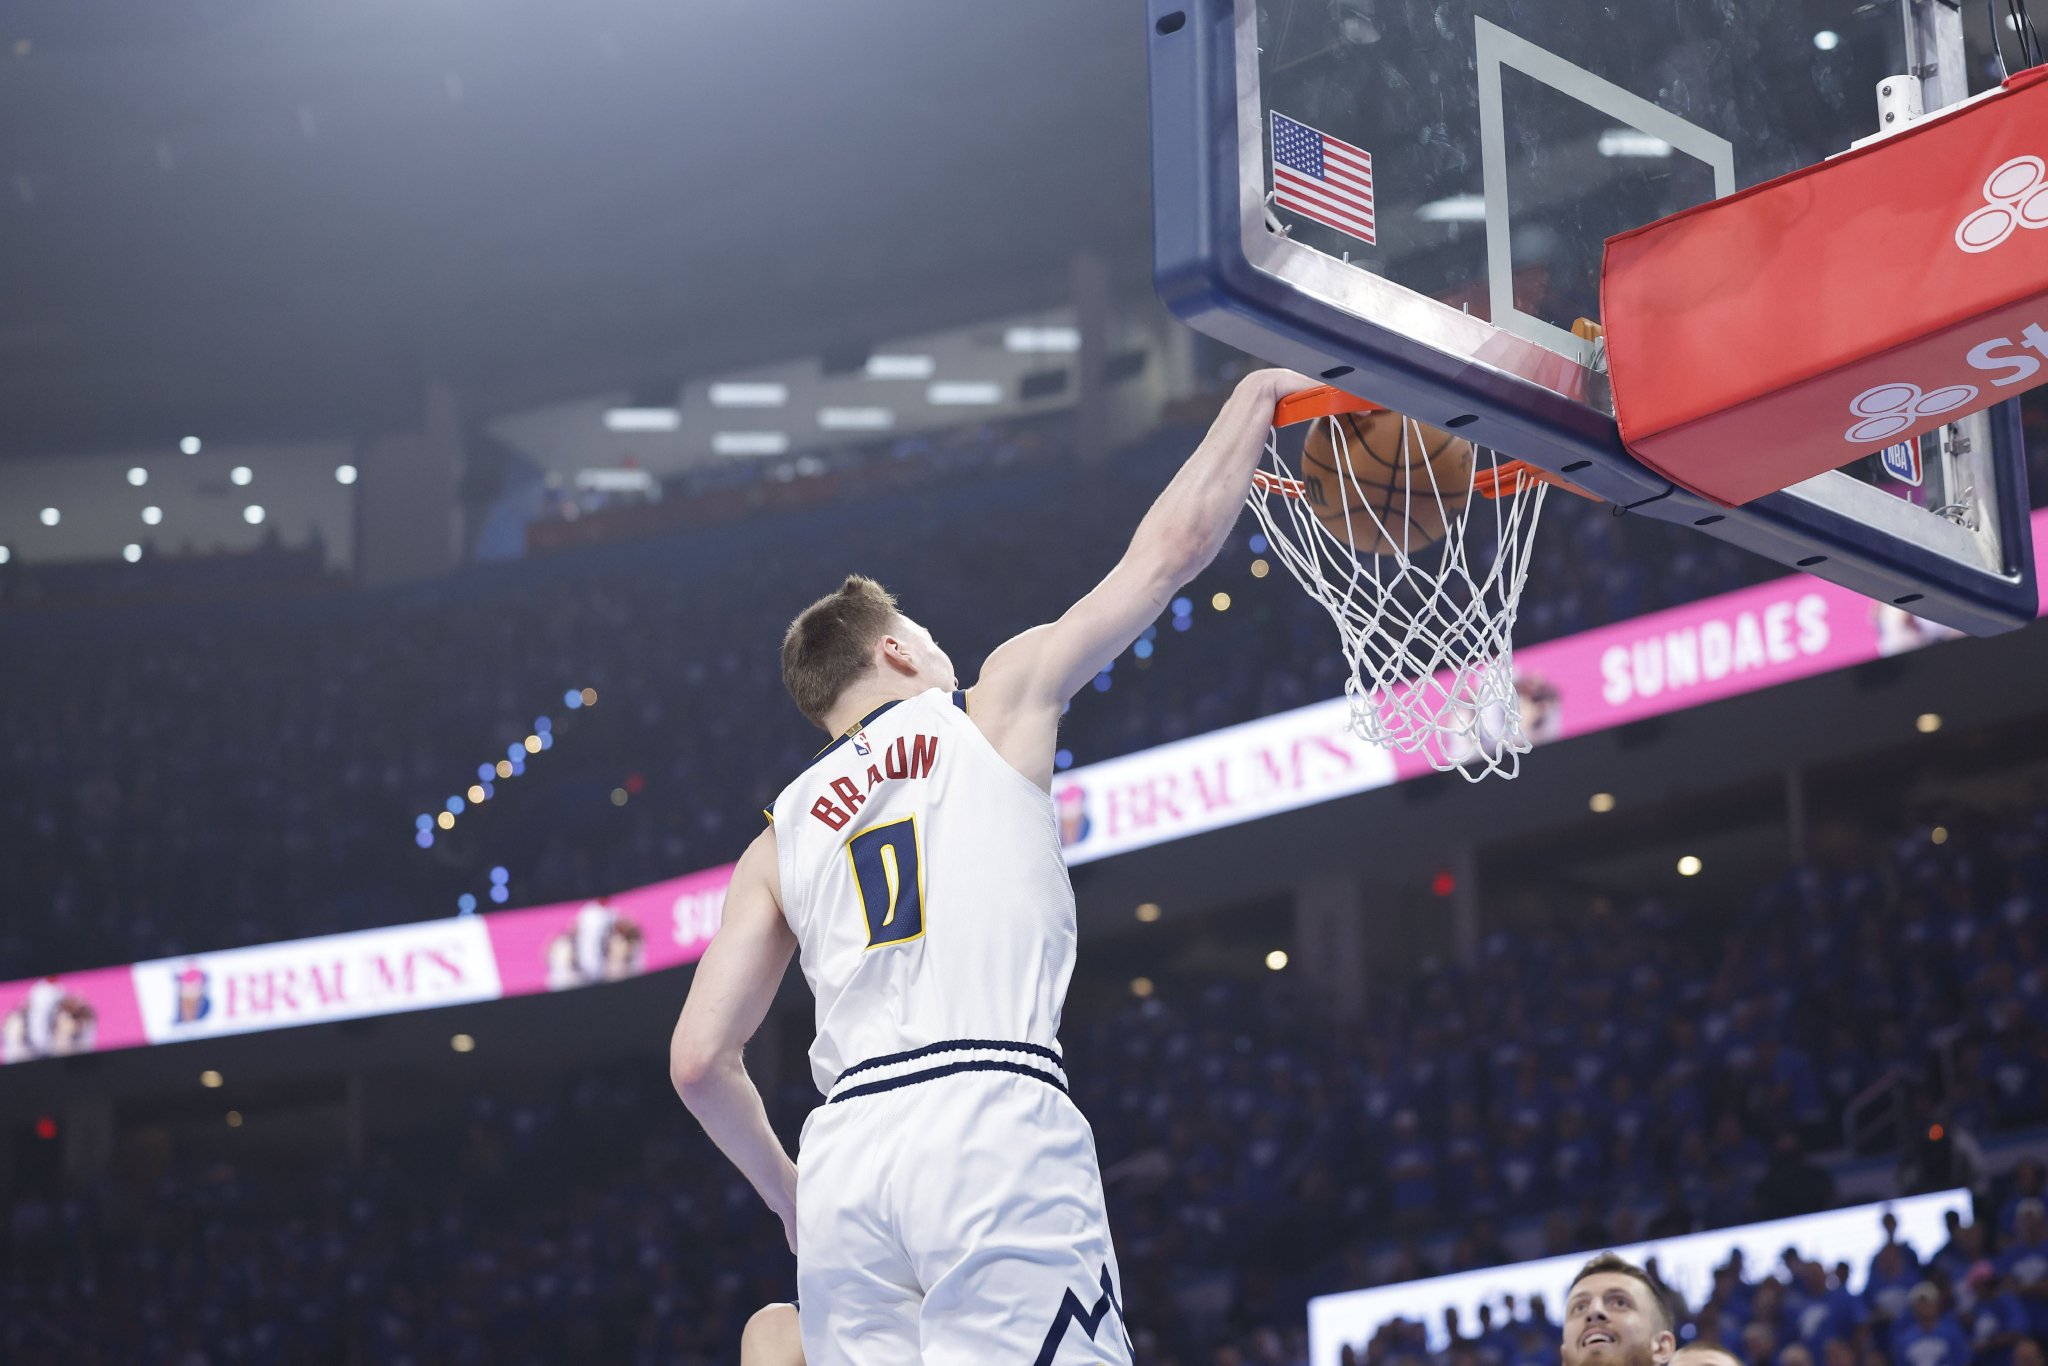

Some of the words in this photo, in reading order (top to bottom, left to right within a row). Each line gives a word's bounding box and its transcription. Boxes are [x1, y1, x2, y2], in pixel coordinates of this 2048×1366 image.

[1887, 443, 1908, 471] NBA
[1602, 593, 1830, 704] SUNDAES
[810, 734, 938, 831] BRAUN
[846, 812, 926, 950] 0
